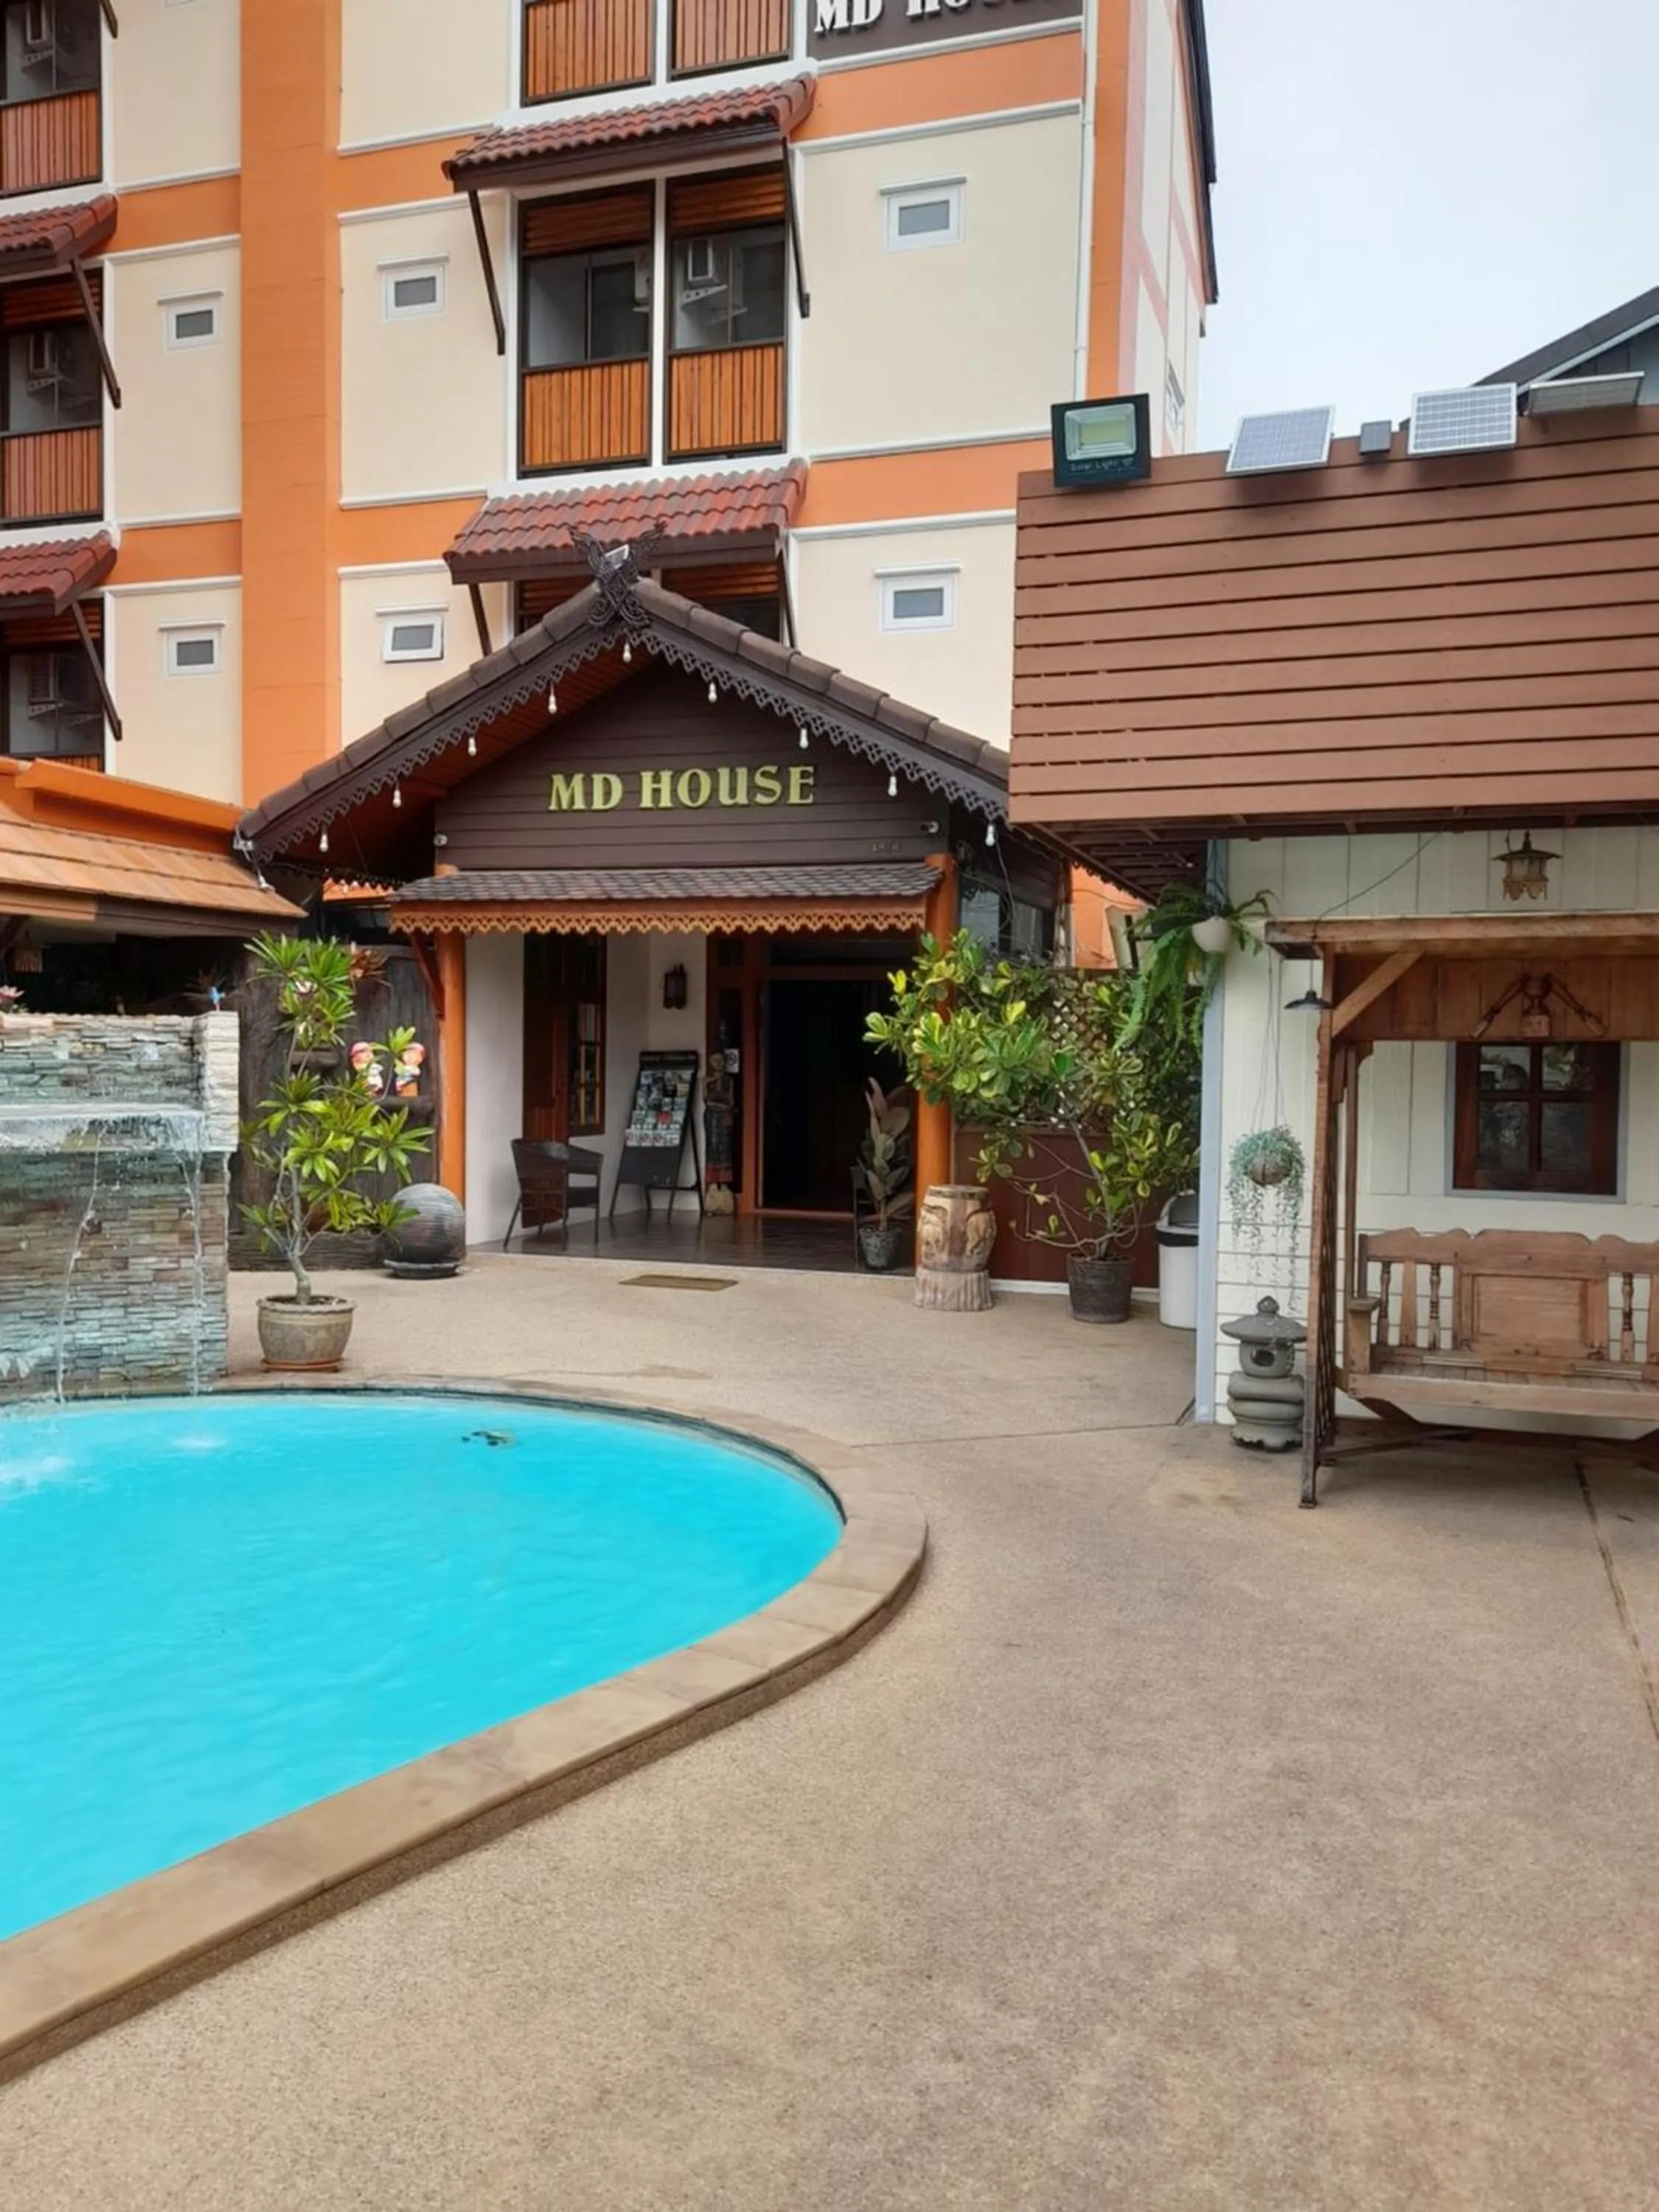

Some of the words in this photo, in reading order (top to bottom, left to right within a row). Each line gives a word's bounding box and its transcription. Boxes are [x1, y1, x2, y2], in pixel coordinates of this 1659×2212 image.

[814, 0, 883, 32] MD
[549, 773, 623, 810] MD
[639, 765, 815, 808] HOUSE
